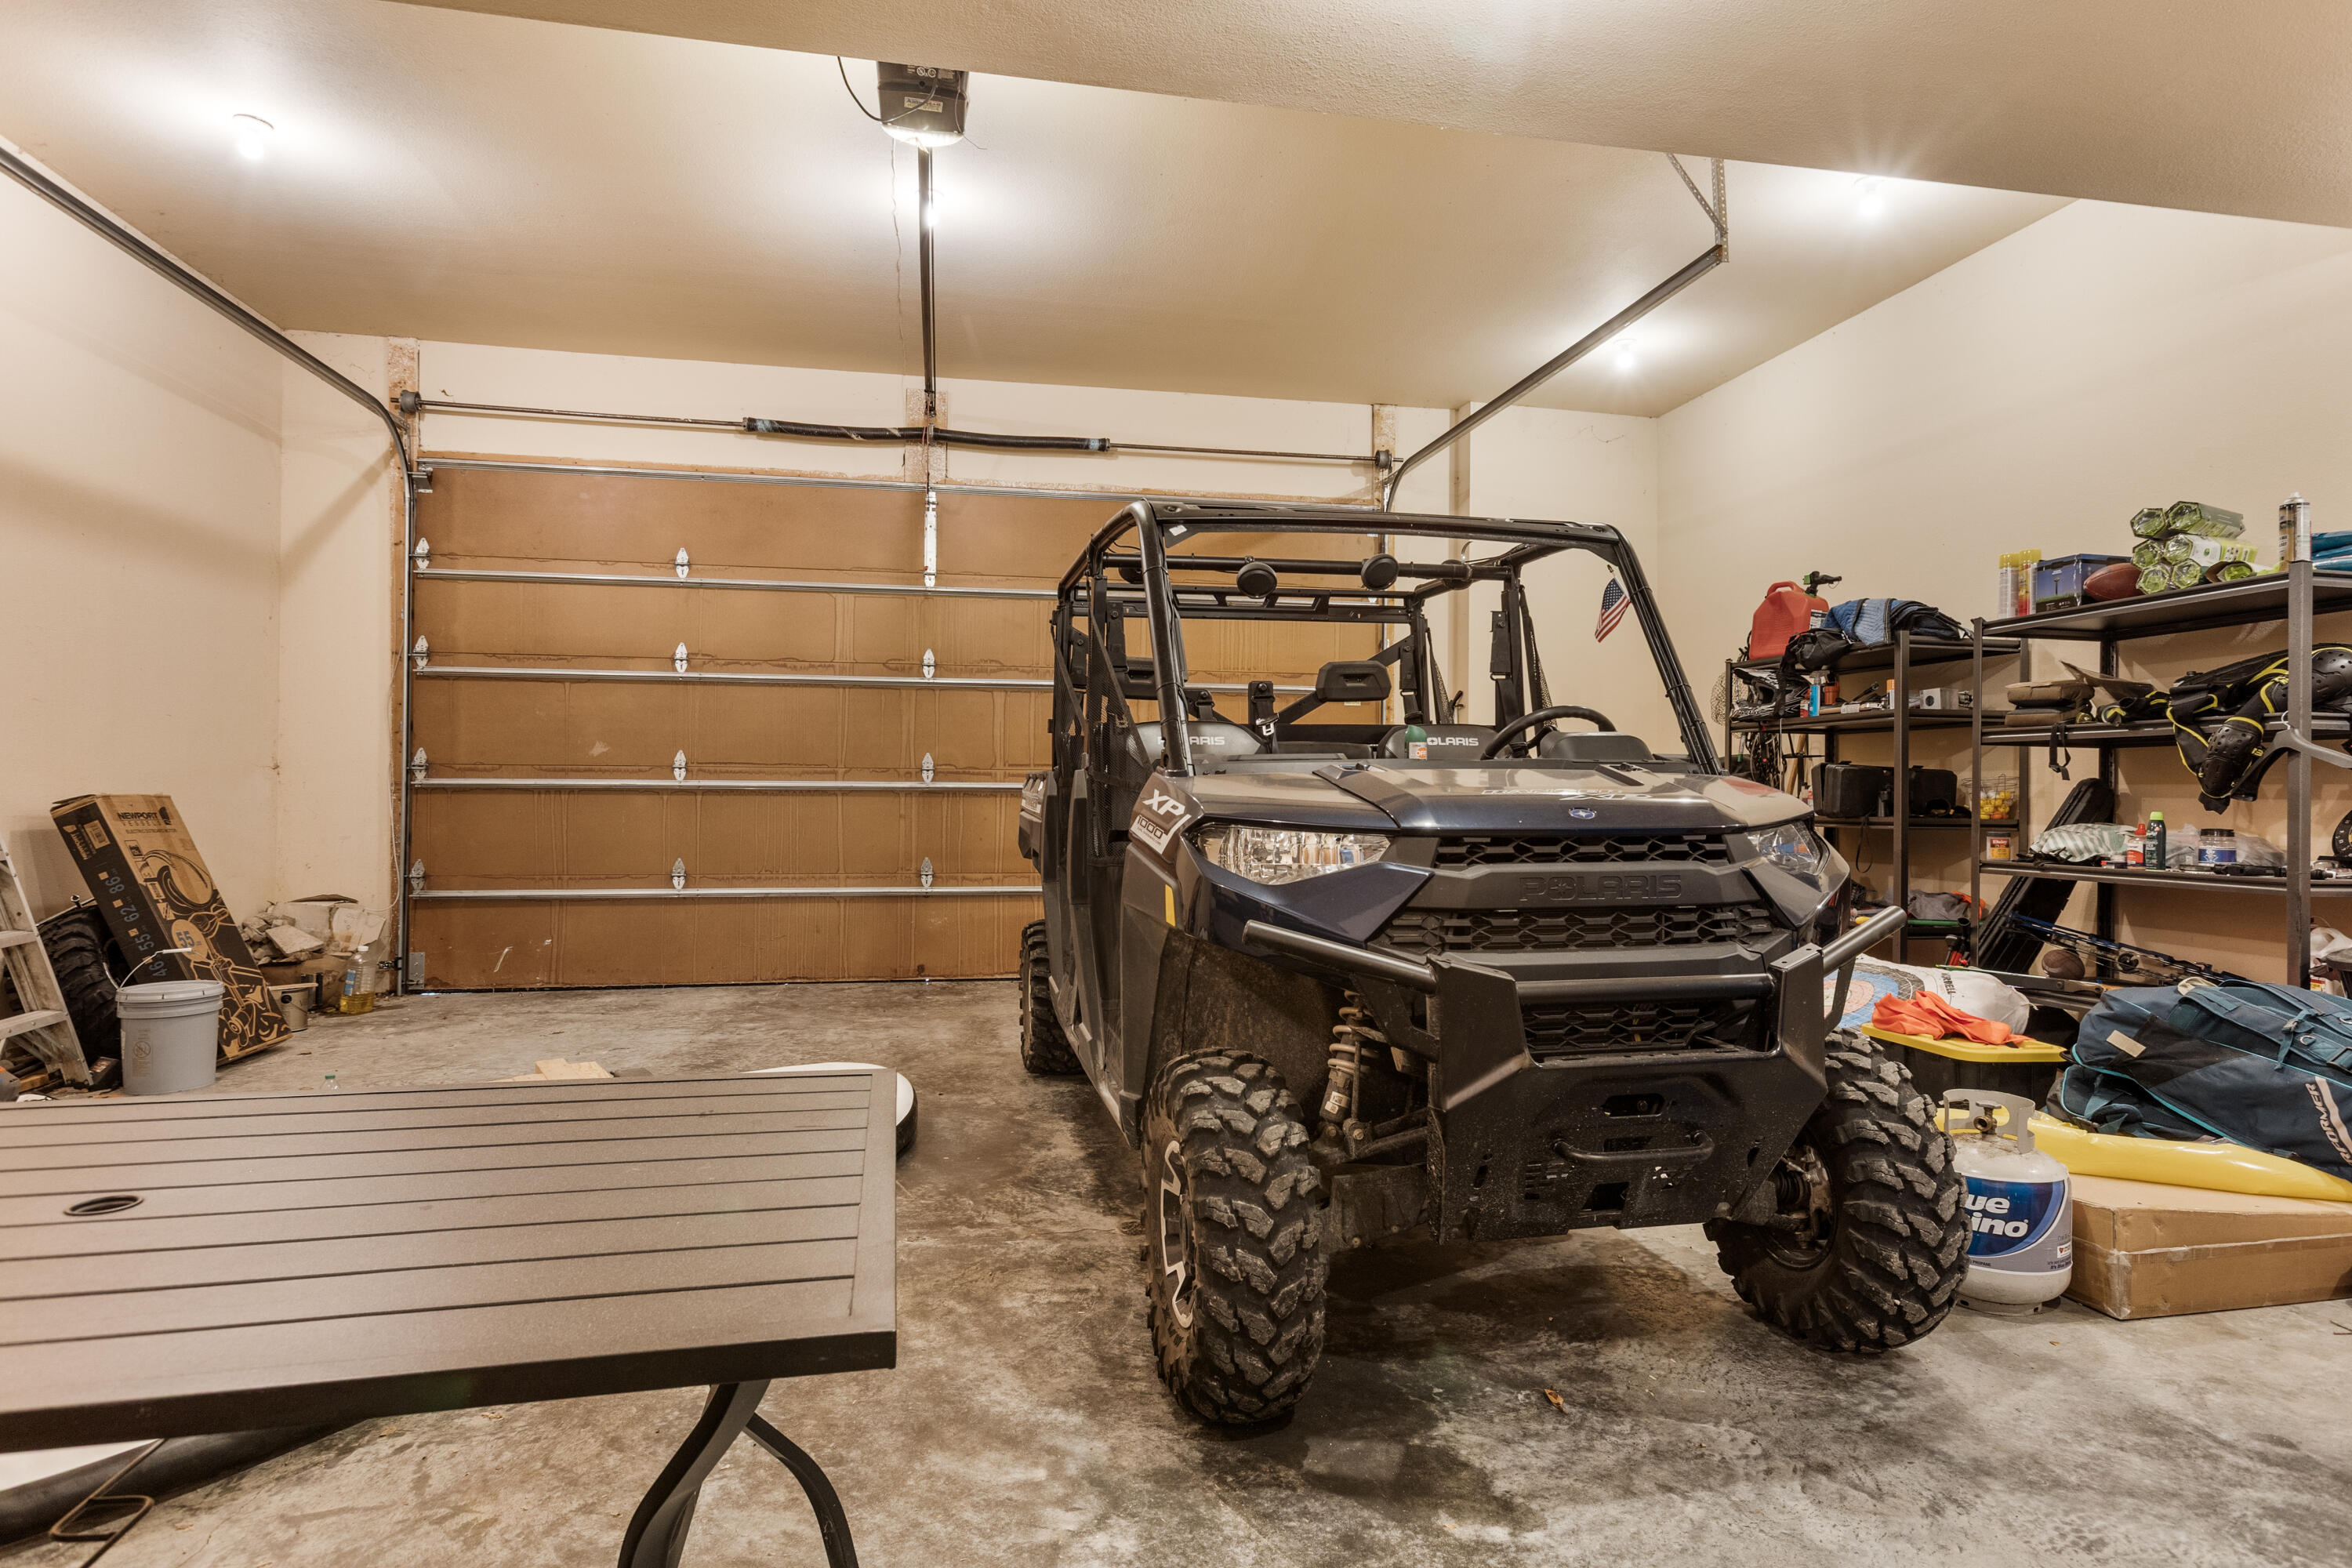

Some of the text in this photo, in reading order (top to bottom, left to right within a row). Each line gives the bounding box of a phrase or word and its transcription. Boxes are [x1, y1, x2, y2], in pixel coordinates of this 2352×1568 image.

[1158, 736, 1225, 745] ARIS
[1427, 737, 1479, 746] OLARIS
[1142, 789, 1185, 815] XP
[1138, 815, 1164, 839] 1000
[106, 877, 125, 894] 86
[1519, 875, 1682, 901] POLARIS
[120, 905, 140, 922] 62
[135, 934, 154, 951] 55
[176, 931, 195, 948] 55
[149, 960, 168, 977] 46
[1965, 1194, 2010, 1214] ue
[1971, 1212, 2028, 1237] ino
